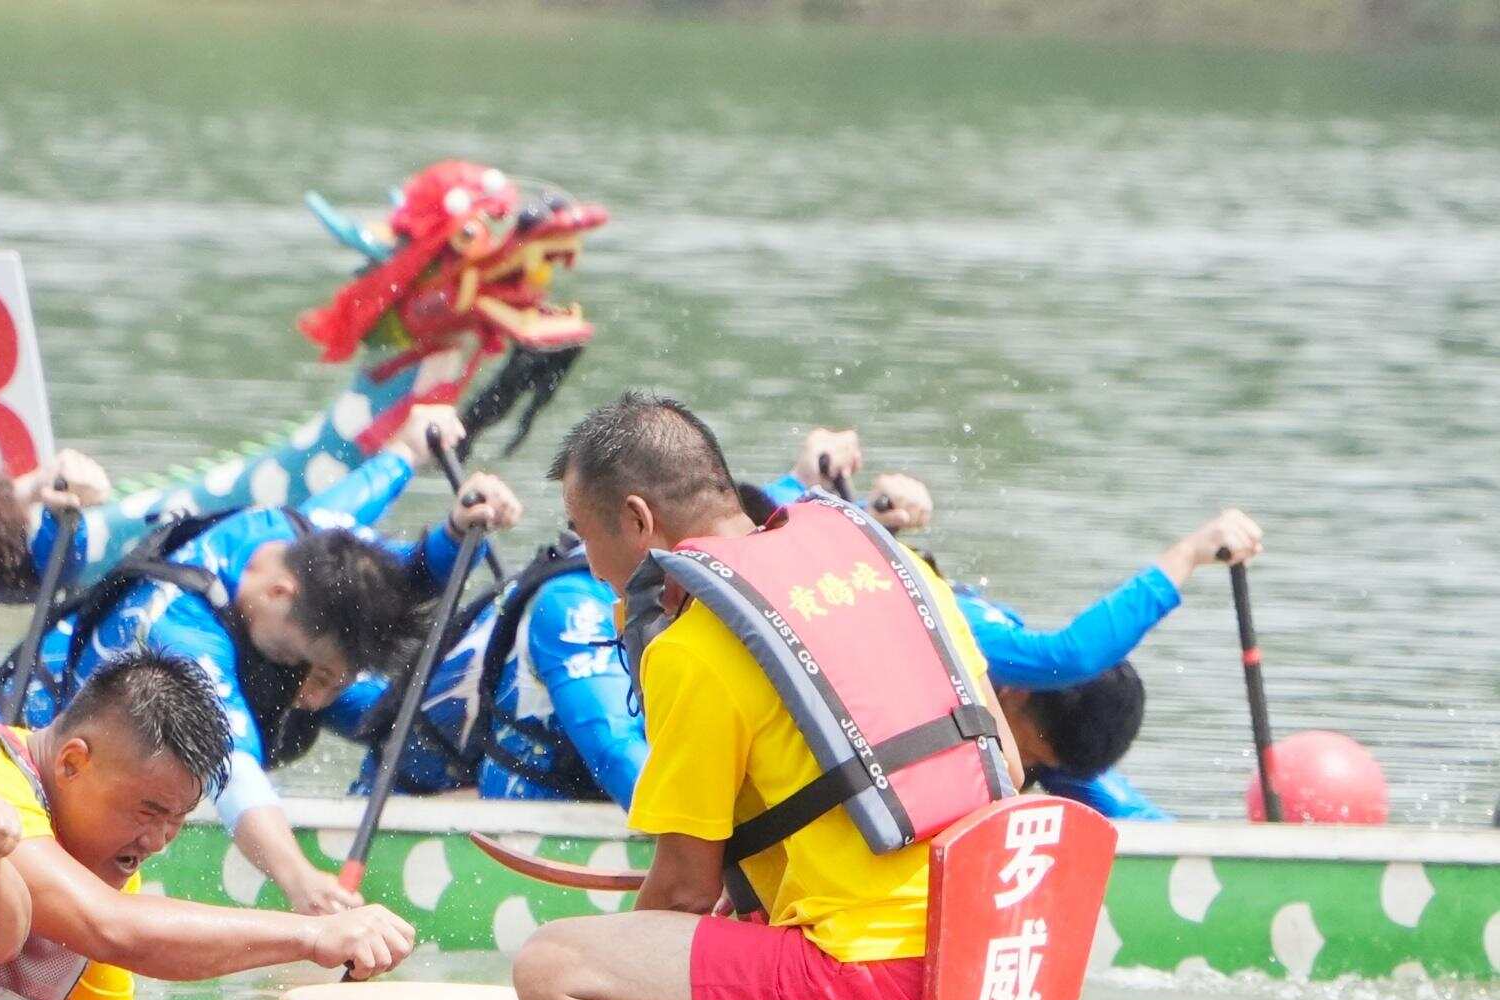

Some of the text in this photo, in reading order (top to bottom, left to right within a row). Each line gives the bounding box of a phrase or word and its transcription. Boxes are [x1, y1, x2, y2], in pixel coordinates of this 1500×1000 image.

[890, 560, 936, 630] JUST GO
[764, 609, 820, 675] JUST GO
[950, 675, 973, 706] JUS
[840, 718, 890, 790] JUST GO
